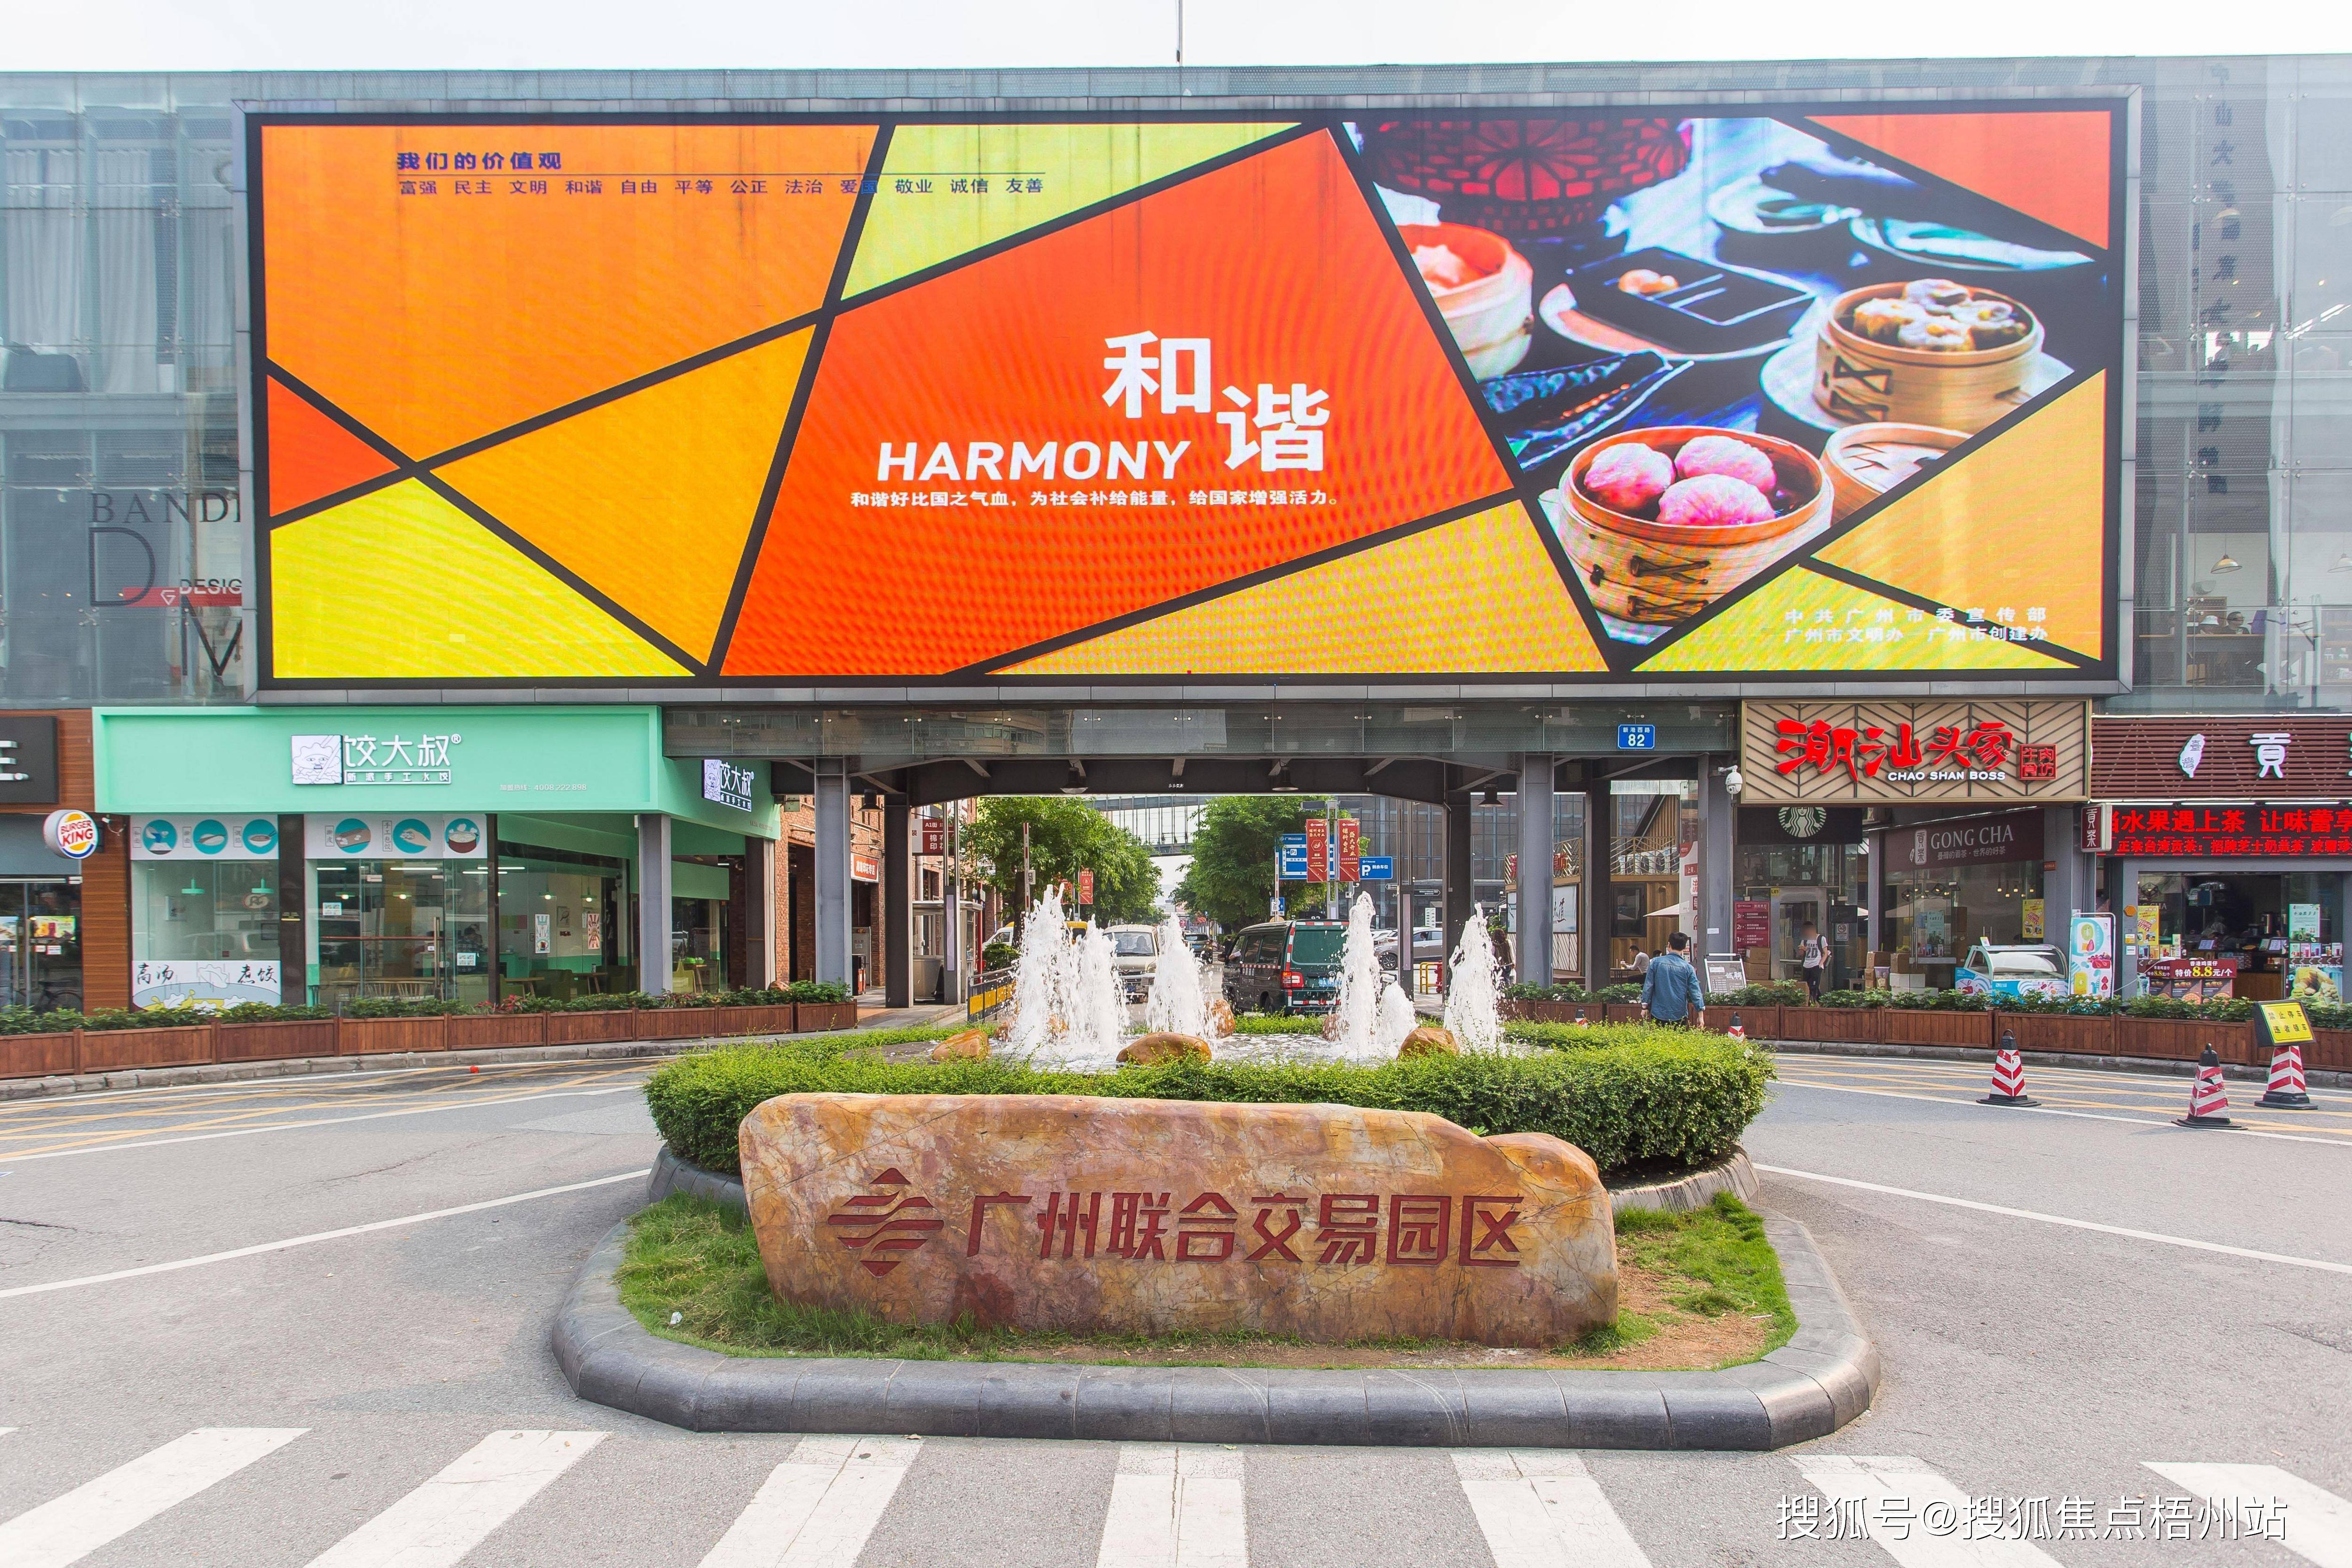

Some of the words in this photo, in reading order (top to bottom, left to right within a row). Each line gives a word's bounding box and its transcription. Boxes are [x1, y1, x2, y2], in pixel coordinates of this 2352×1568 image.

[397, 152, 562, 170] 我们的价值观
[399, 180, 437, 195] 富强
[454, 180, 492, 195] 民主
[509, 180, 548, 195] 文明
[565, 180, 603, 194] 和谐
[621, 180, 657, 194] 自由
[675, 180, 714, 194] 平等
[730, 179, 768, 194] 公正
[785, 179, 823, 194] 法治
[840, 179, 878, 194] 爱国
[895, 178, 933, 194] 敬业
[951, 178, 988, 193] 诚信
[1006, 178, 1044, 193] 友善
[1102, 330, 1330, 472] 和谐
[877, 440, 1192, 481] HARMONY
[1786, 607, 2047, 623] 中共广州市委宣传部
[1785, 628, 1904, 643] 广州市文明办
[1929, 626, 2048, 642] 广州市创建办
[1628, 734, 1645, 747] 82
[344, 734, 451, 767] 饺大叔
[1774, 719, 2014, 783] 潮汕头家
[720, 760, 752, 797] 饺大叔
[1888, 771, 1925, 781] CHAO
[1930, 771, 1964, 780] SHAN
[1969, 771, 2006, 780] BOSS
[61, 820, 92, 835] BURGER
[1931, 829, 1975, 849] GONG
[1979, 824, 2014, 844] CHA
[62, 828, 94, 847] KING
[138, 963, 174, 984] 高汤
[238, 964, 277, 983] 煮饺
[2175, 966, 2233, 977] 特价8.8元/个
[2268, 1011, 2302, 1020] 禁止停车
[966, 1191, 1526, 1267] 广州联合交易园区
